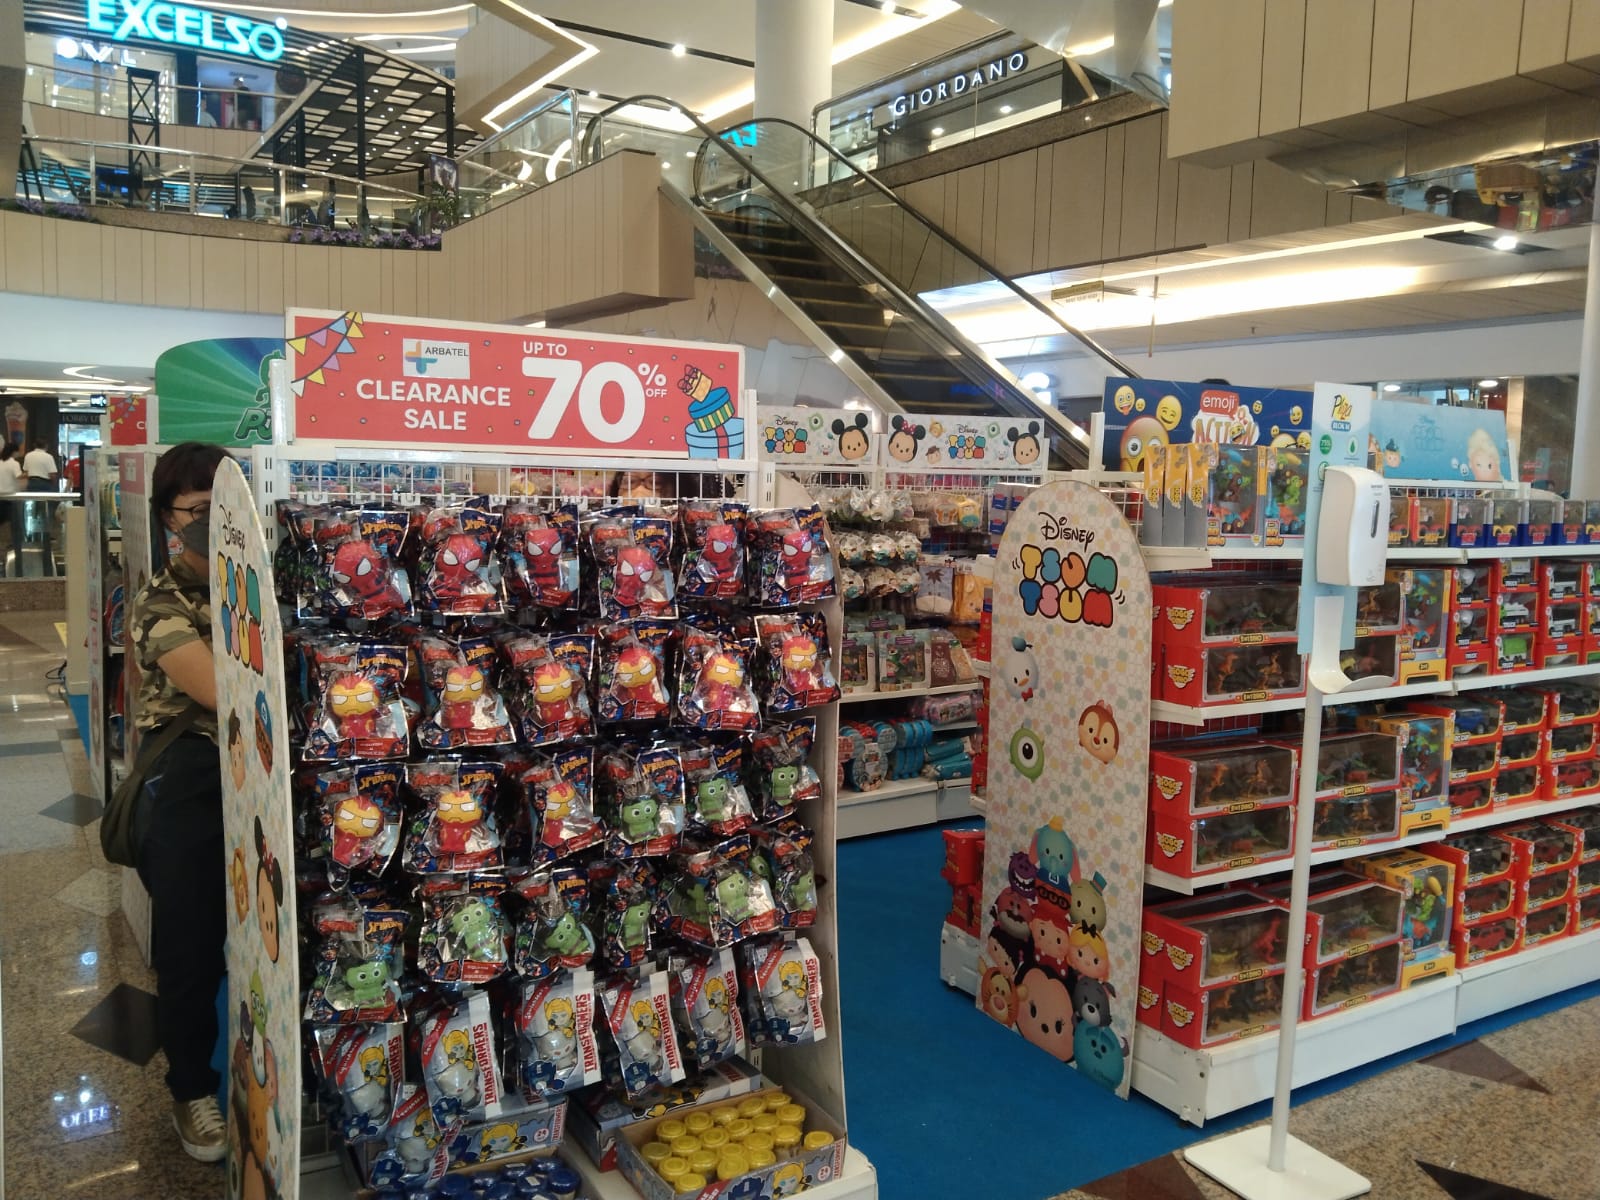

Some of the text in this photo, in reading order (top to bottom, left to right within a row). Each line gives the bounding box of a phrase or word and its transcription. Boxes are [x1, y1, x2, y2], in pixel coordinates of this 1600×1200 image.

[87, 0, 285, 62] EXCELSO
[893, 51, 1027, 118] GIORDANO
[425, 345, 470, 358] ARBATEL
[523, 341, 568, 357] UP TO
[356, 379, 511, 407] CLEARANCE
[645, 387, 668, 399] OFF
[1202, 395, 1236, 413] emoji
[403, 408, 467, 431] SALE
[1038, 511, 1096, 553] Disney
[575, 993, 598, 1074] TRANSFORMERS
[653, 993, 679, 1070] TRANSFORMERS
[473, 1022, 497, 1106] TRANSFORMERS
